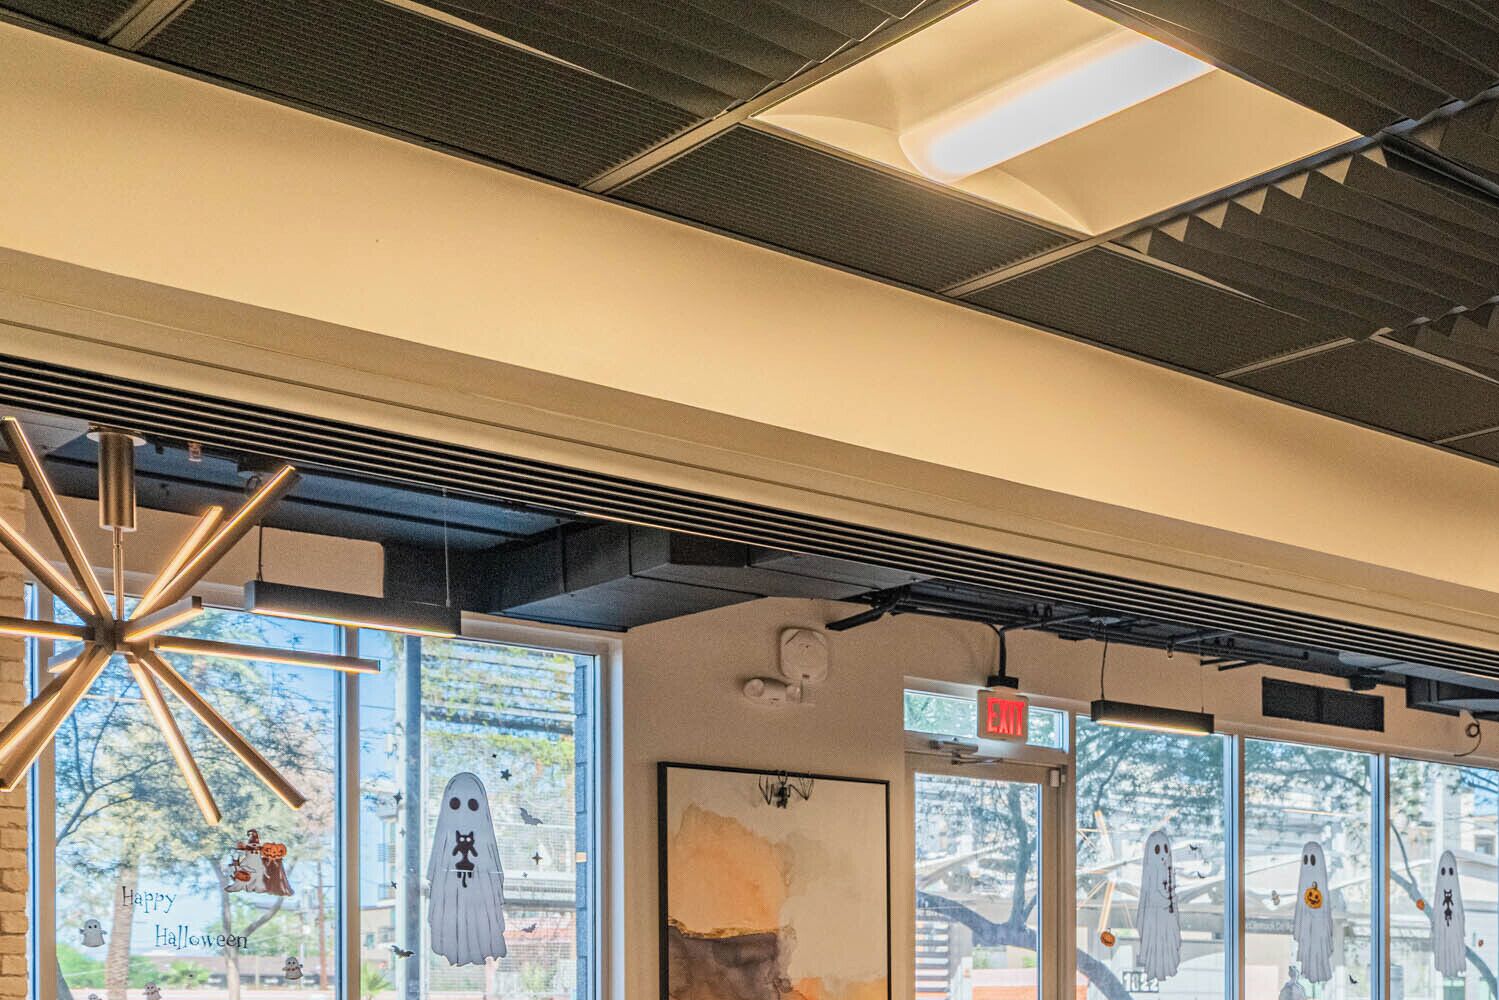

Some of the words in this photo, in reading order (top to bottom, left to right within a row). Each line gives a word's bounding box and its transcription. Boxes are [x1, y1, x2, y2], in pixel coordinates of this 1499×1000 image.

[986, 697, 1025, 737] EXIT
[122, 886, 176, 913] Happy
[155, 924, 248, 950] Halloween
[1123, 972, 1158, 991] 1022
